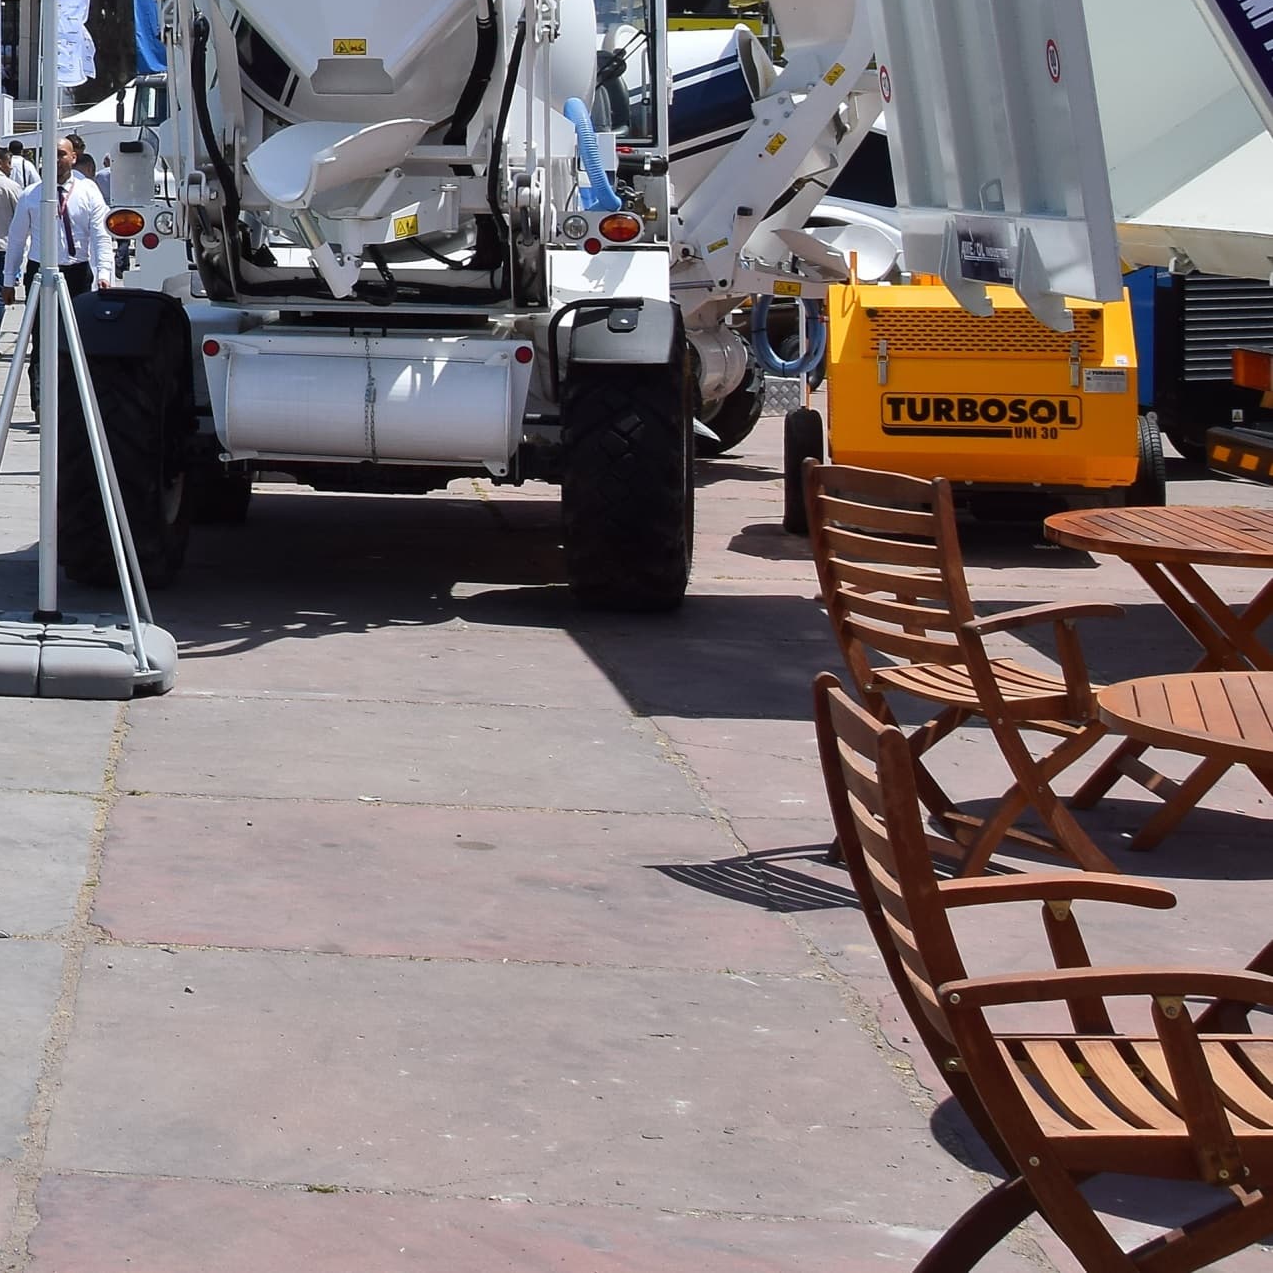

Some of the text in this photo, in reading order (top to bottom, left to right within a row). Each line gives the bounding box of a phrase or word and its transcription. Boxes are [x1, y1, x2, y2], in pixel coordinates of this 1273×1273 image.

[887, 397, 1077, 425] TURBOSOL
[1015, 426, 1058, 440] UNI 30
